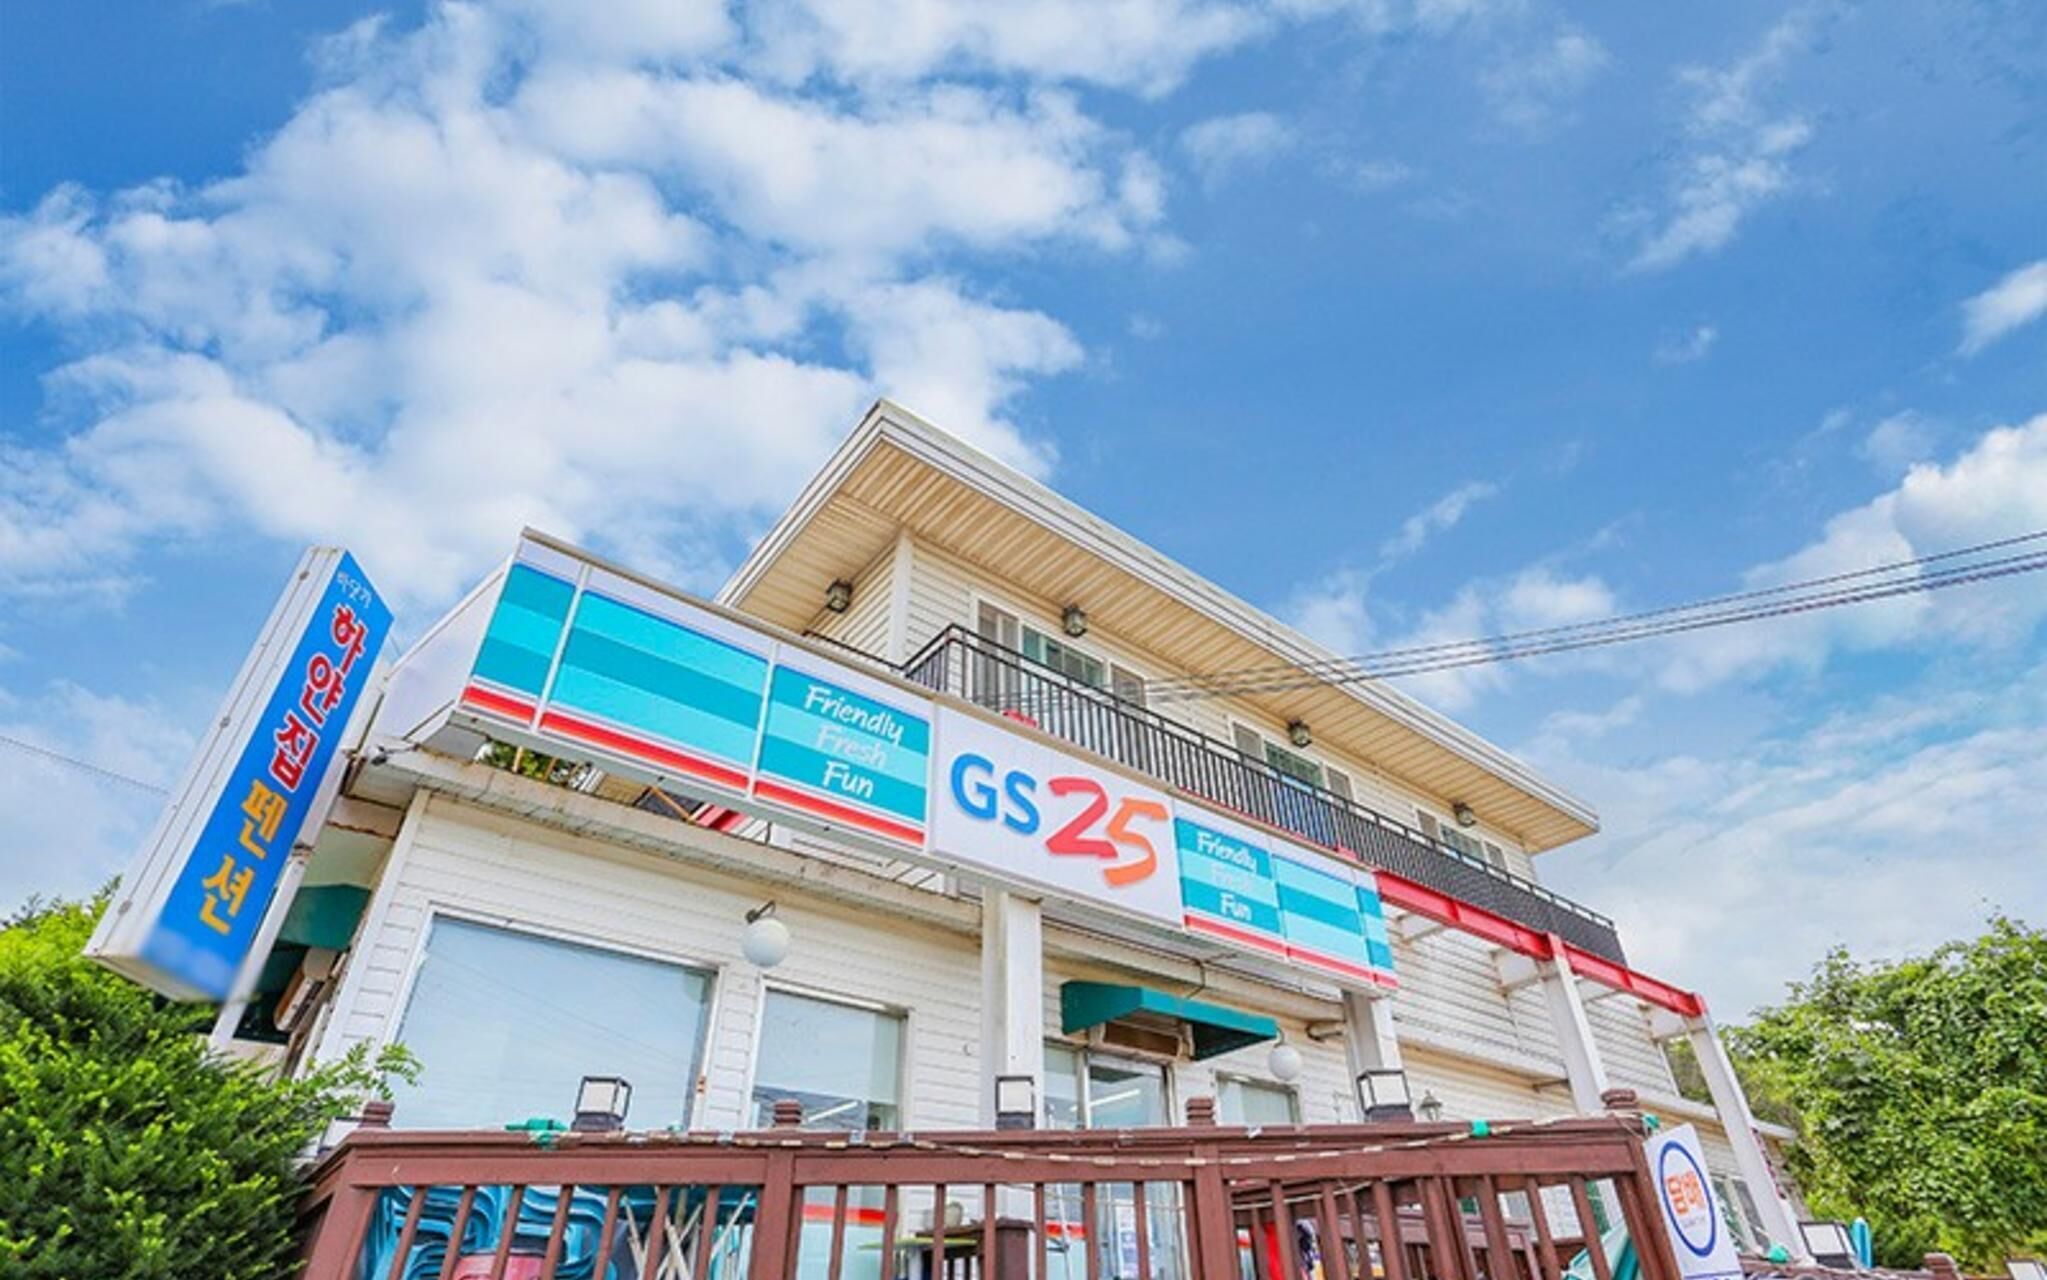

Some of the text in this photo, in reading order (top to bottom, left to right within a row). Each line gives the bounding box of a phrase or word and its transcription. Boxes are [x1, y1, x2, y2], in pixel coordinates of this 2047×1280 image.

[804, 684, 904, 747] Friendly
[816, 723, 888, 769] Fresh
[200, 603, 368, 935] 하얀집 펜션
[822, 760, 874, 799] Fun
[951, 753, 1169, 888] GS25
